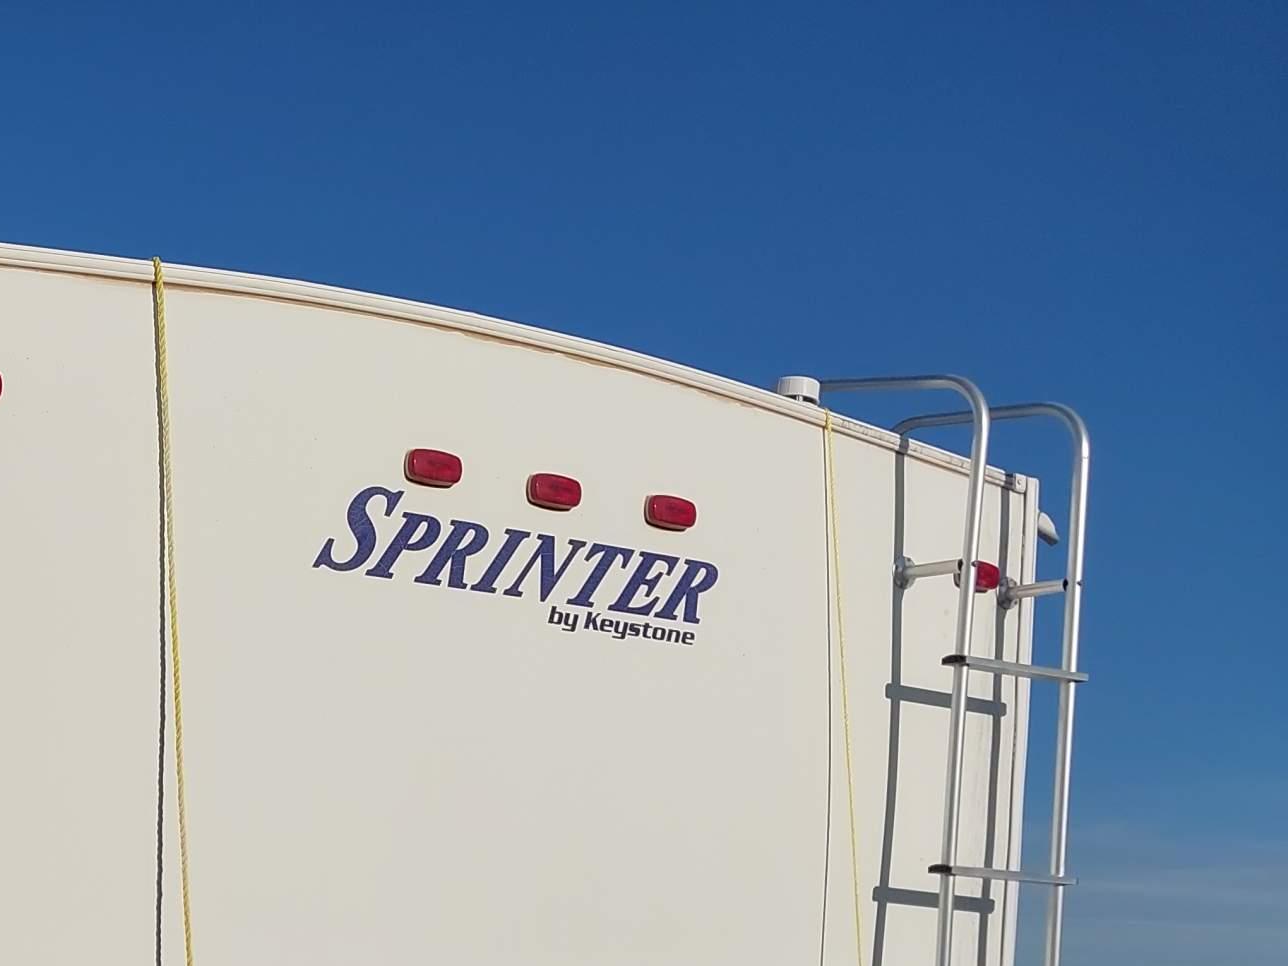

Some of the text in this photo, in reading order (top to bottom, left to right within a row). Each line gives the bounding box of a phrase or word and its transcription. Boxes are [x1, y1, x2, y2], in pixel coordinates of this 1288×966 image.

[313, 486, 719, 624] SPRINTER
[548, 605, 696, 645] by Keystone
